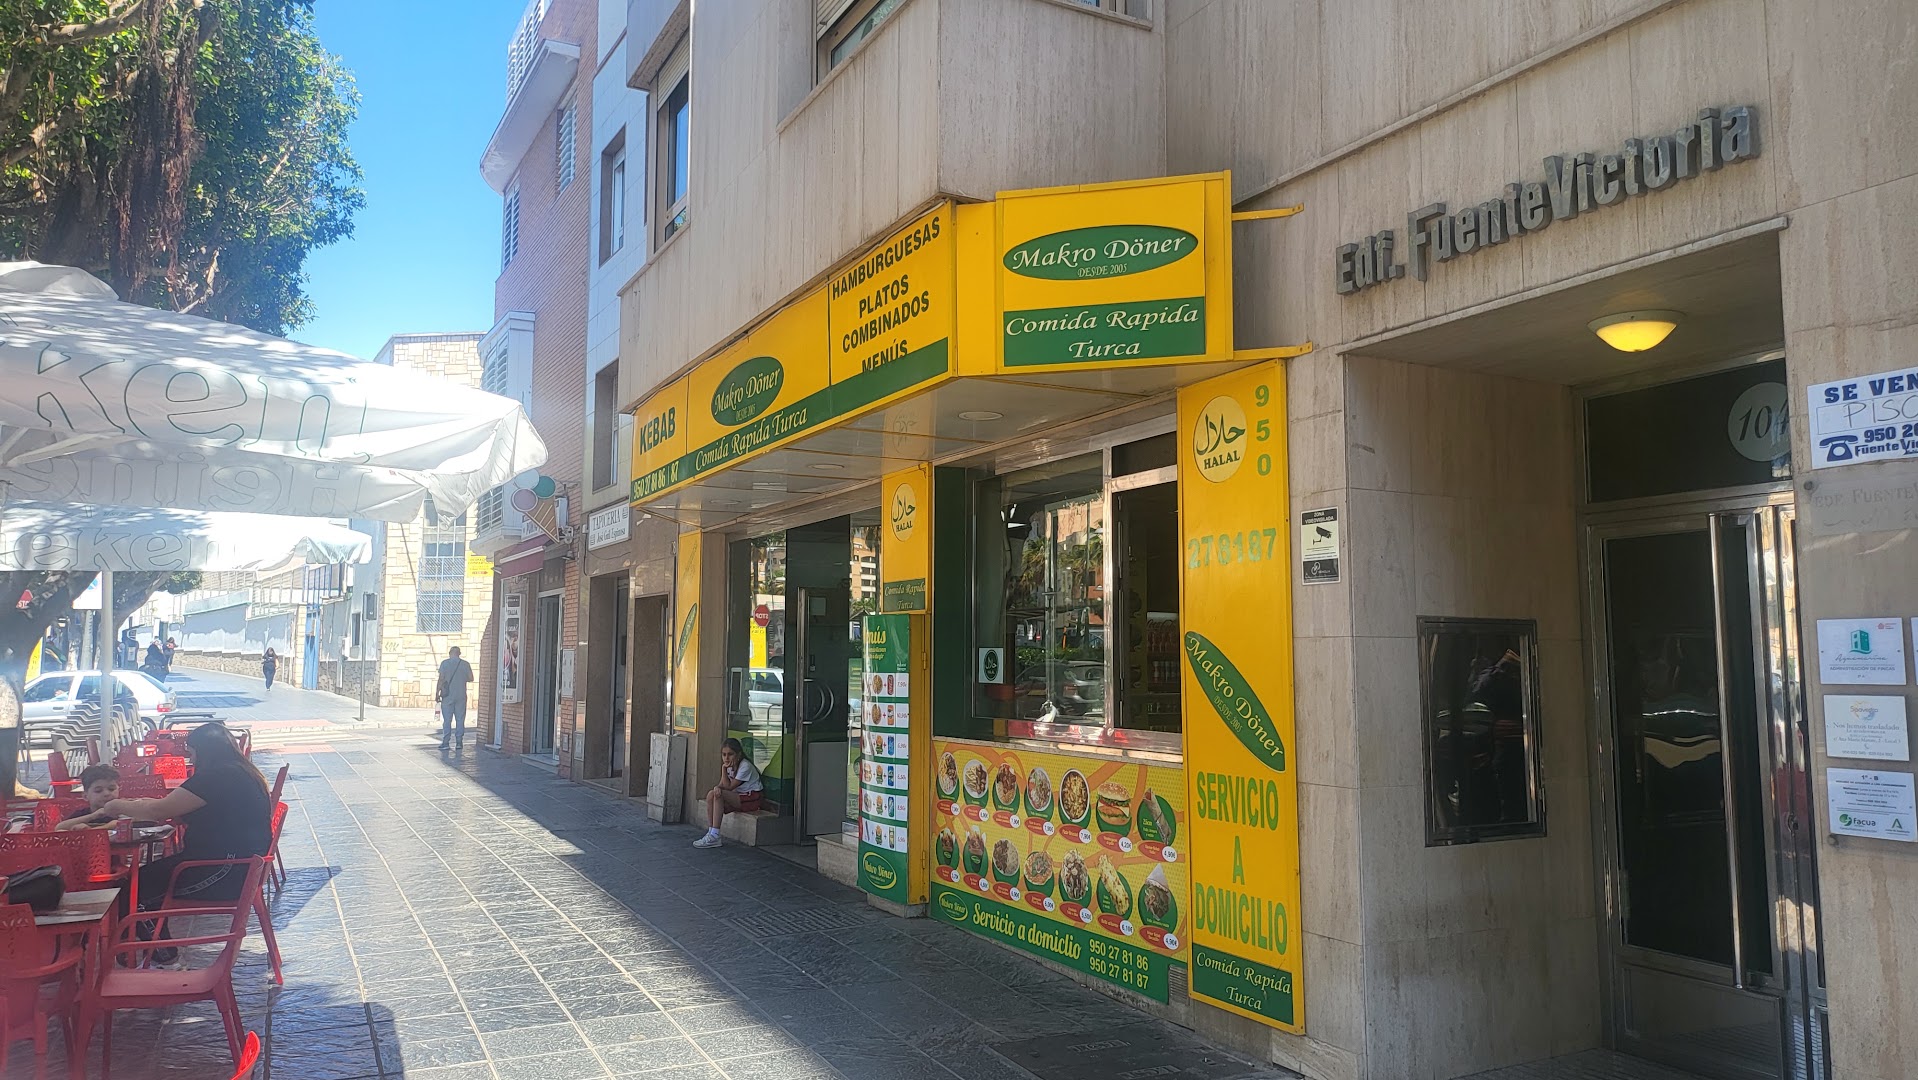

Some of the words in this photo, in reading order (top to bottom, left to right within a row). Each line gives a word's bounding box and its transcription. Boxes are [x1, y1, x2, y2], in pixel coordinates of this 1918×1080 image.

[1407, 105, 1760, 283] FuenteVictoria
[832, 215, 940, 301] HAMBURGUESAS
[1012, 242, 1096, 270] Makro
[1103, 236, 1187, 260] Döner
[1077, 264, 1108, 278] DESDE
[1109, 263, 1127, 275] 2005
[858, 273, 910, 319] PLATOS
[842, 290, 930, 354] COMBINADOS
[1006, 310, 1098, 336] Comida
[1105, 303, 1199, 332] Rapida
[861, 338, 909, 372] MENÚS
[1068, 339, 1141, 359] Turca
[714, 382, 744, 416] Makro
[745, 368, 781, 399] Döner
[1824, 383, 1858, 404] SE
[639, 406, 677, 456] KEBAB
[695, 436, 729, 471] Comida
[731, 418, 771, 455] Rapida
[771, 408, 808, 436] Turca
[1196, 413, 1246, 456] حلال
[1864, 426, 1897, 443] 950
[1203, 449, 1241, 471] HALAL
[633, 478, 645, 500] 950
[670, 460, 680, 483] 87
[895, 520, 913, 533] HALAL
[1187, 527, 1277, 570] 278187
[884, 583, 905, 597] Comida
[1186, 634, 1234, 698] Makro
[1235, 697, 1284, 757] Döner
[1213, 695, 1232, 721] DESDE
[1229, 716, 1243, 733] 2005
[1196, 770, 1279, 831] SERVICIO
[1853, 817, 1876, 827] facua
[1232, 835, 1245, 886] A
[972, 902, 1015, 938] Servicio
[1017, 928, 1026, 941] a
[1195, 882, 1288, 956] DOMICILIO
[1089, 938, 1106, 957] 950
[1108, 944, 1120, 962] 27
[1122, 949, 1134, 966] 81
[1136, 953, 1149, 972] 86
[1089, 956, 1106, 975] 950
[1108, 962, 1120, 979] 27
[1122, 967, 1134, 985] 81
[1136, 971, 1149, 990] 87
[1196, 951, 1241, 978] Comida
[1243, 966, 1292, 994] Rapida
[1225, 986, 1263, 1011] Turca
